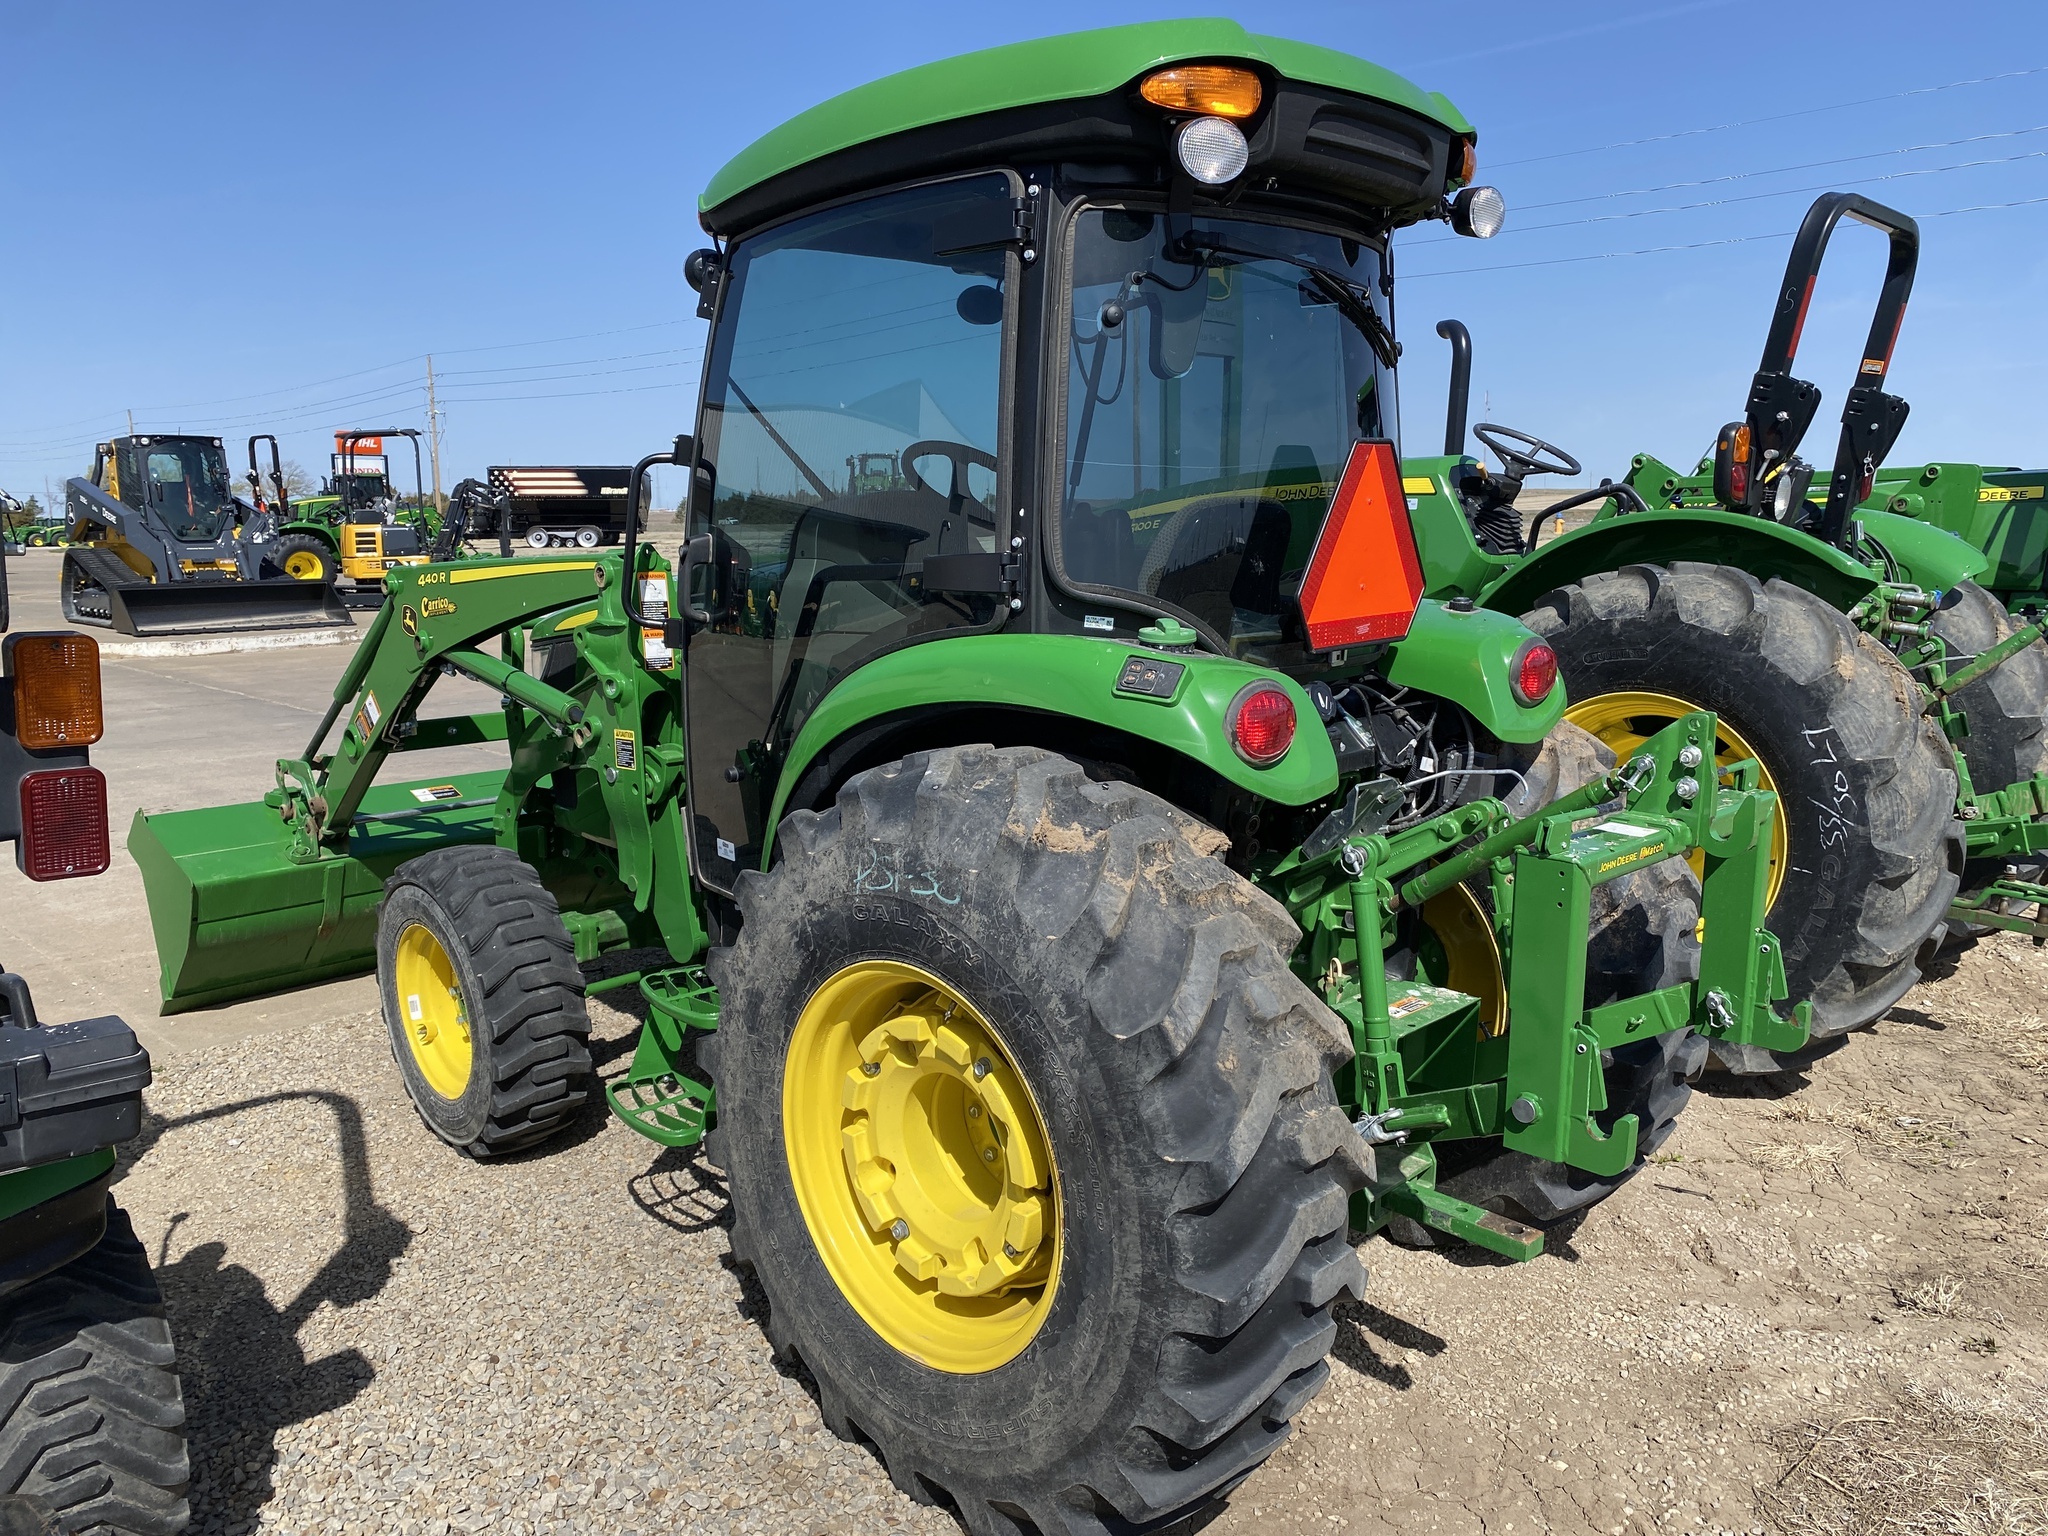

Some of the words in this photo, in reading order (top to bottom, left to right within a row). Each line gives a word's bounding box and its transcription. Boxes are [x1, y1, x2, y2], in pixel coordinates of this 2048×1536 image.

[345, 438, 378, 448] SIHL
[1274, 488, 1309, 501] JOHN
[1309, 485, 1335, 500] DEE
[1978, 490, 2029, 501] DEERE
[417, 573, 438, 587] 440
[439, 572, 446, 583] R
[421, 596, 449, 618] Carrico
[1598, 859, 1617, 874] JOHN
[1616, 851, 1638, 867] DEERE
[1785, 854, 1842, 962] GALA
[852, 903, 983, 967] GALAXY
